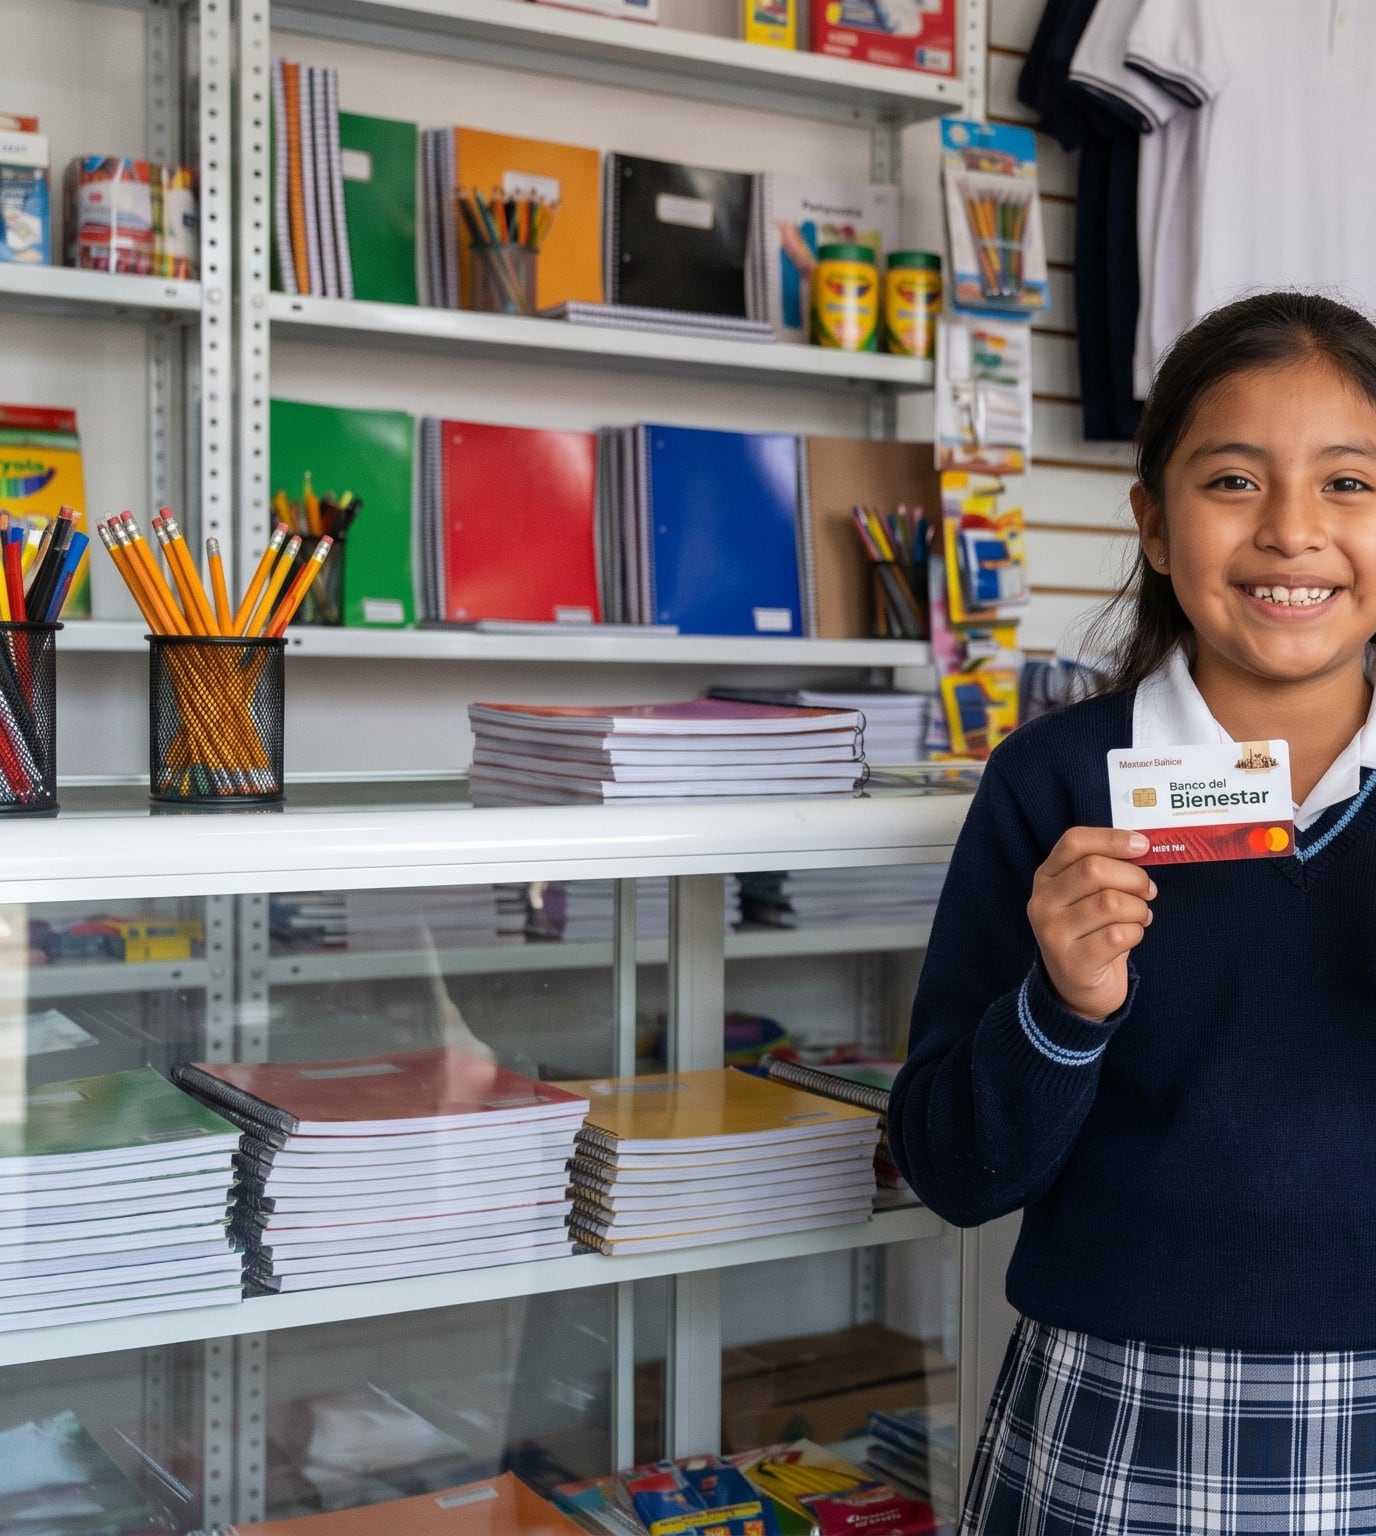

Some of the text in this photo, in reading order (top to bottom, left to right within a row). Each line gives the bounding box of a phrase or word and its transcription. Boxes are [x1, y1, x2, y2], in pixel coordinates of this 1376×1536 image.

[1169, 778, 1227, 791] Banco del
[1170, 790, 1269, 809] Bienestar
